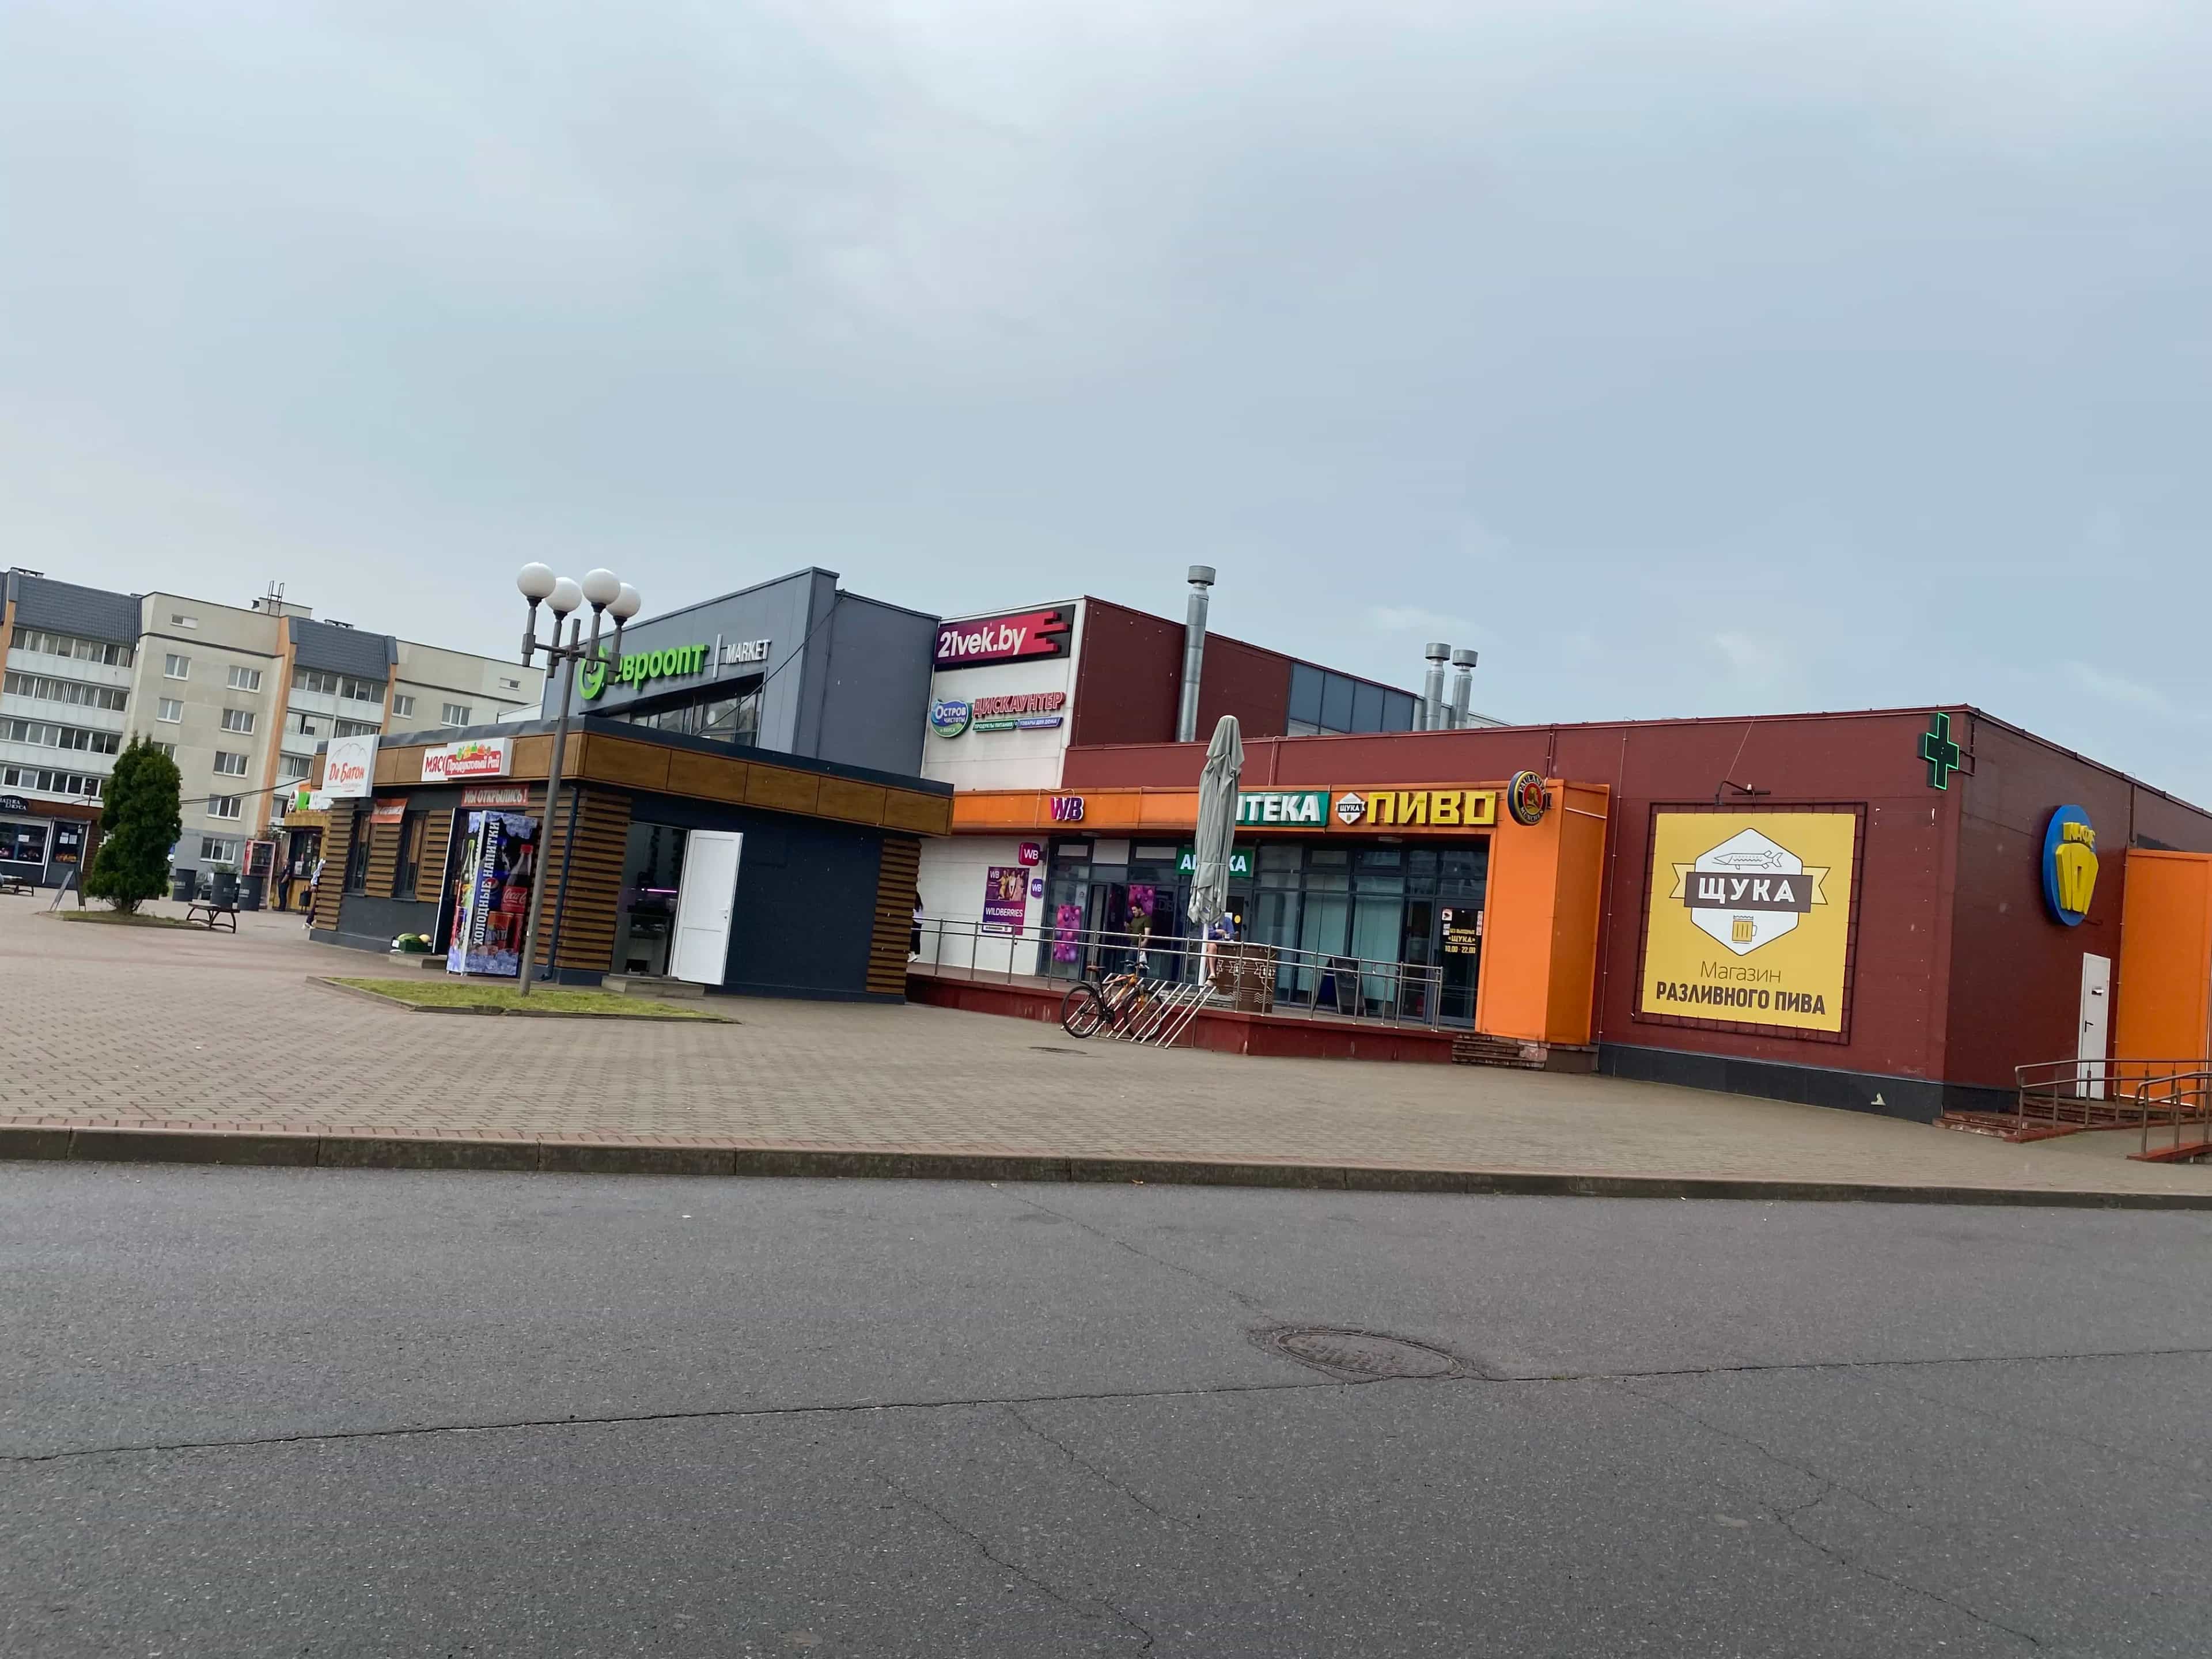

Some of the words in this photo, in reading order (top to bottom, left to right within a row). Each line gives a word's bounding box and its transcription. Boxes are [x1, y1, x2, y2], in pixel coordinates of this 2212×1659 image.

[725, 639, 771, 664] MARKET
[938, 624, 1027, 658] 21vek.by
[973, 691, 1063, 719] ДИСКАУНТЕР
[477, 788, 522, 802] ОТКРЫЛИСЬ
[1051, 797, 1084, 820] WB
[1236, 795, 1320, 822] ТЕКА
[1339, 803, 1360, 812] ЩУКА
[1367, 792, 1497, 824] ПИВО
[1024, 849, 1039, 859] WB
[1180, 854, 1247, 872] АКА
[473, 881, 491, 945] ХОЛОДНЫЕ
[483, 821, 499, 878] НАПИТКИ
[990, 870, 1000, 878] WB
[1032, 883, 1042, 892] WB
[1698, 877, 1796, 904] ЩУКА
[986, 907, 1023, 918] WILDBERRIES
[1700, 960, 1782, 983] Магазин
[1656, 981, 1770, 1009] РАЗЛИВНОГО
[1775, 991, 1826, 1015] ПИВА
